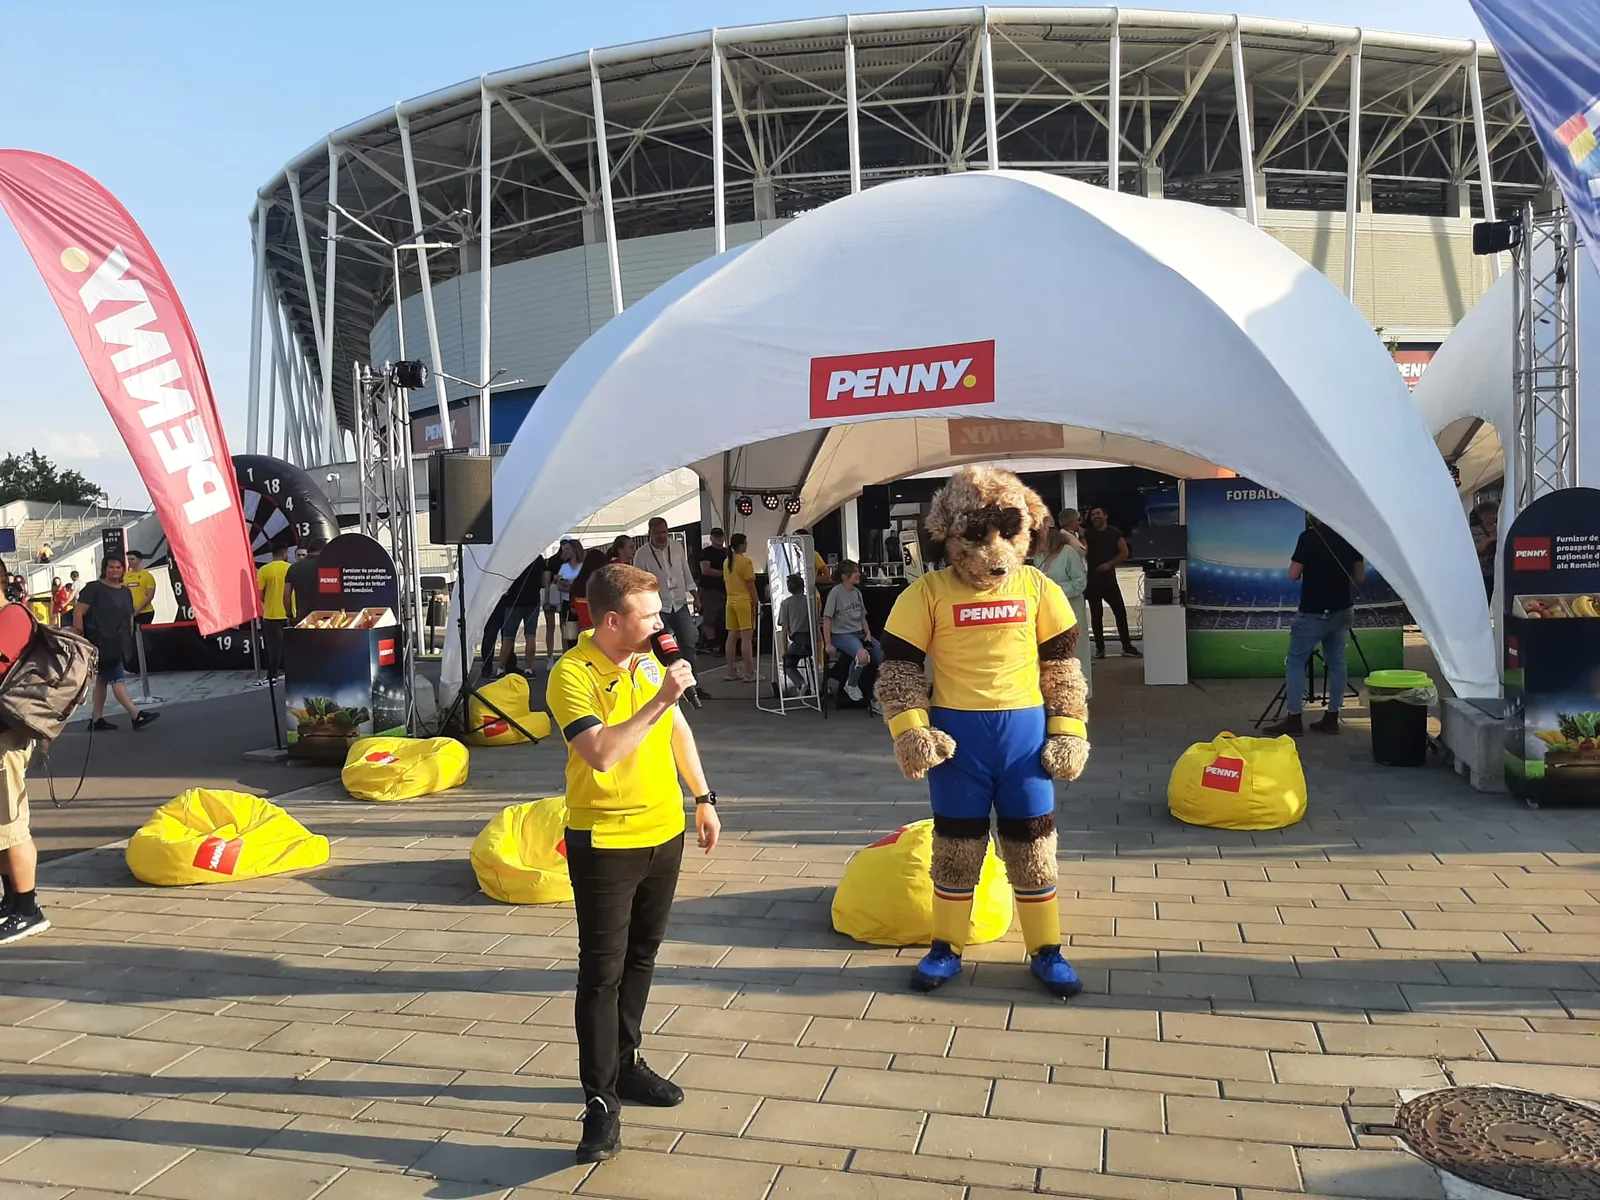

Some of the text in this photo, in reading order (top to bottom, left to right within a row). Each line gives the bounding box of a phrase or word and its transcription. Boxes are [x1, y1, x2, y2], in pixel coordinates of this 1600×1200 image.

[61, 244, 231, 525] PENNY.
[826, 358, 977, 401] PENNY.
[247, 468, 253, 482] 1
[264, 479, 280, 494] 18
[286, 496, 293, 511] 4
[296, 522, 310, 536] 13
[1556, 544, 1595, 552] proaspete
[174, 582, 182, 595] 8
[182, 606, 196, 619] 16
[960, 604, 1023, 621] PENNY.
[217, 636, 232, 650] 19
[243, 639, 250, 653] 3
[1205, 766, 1239, 778] PENNY.
